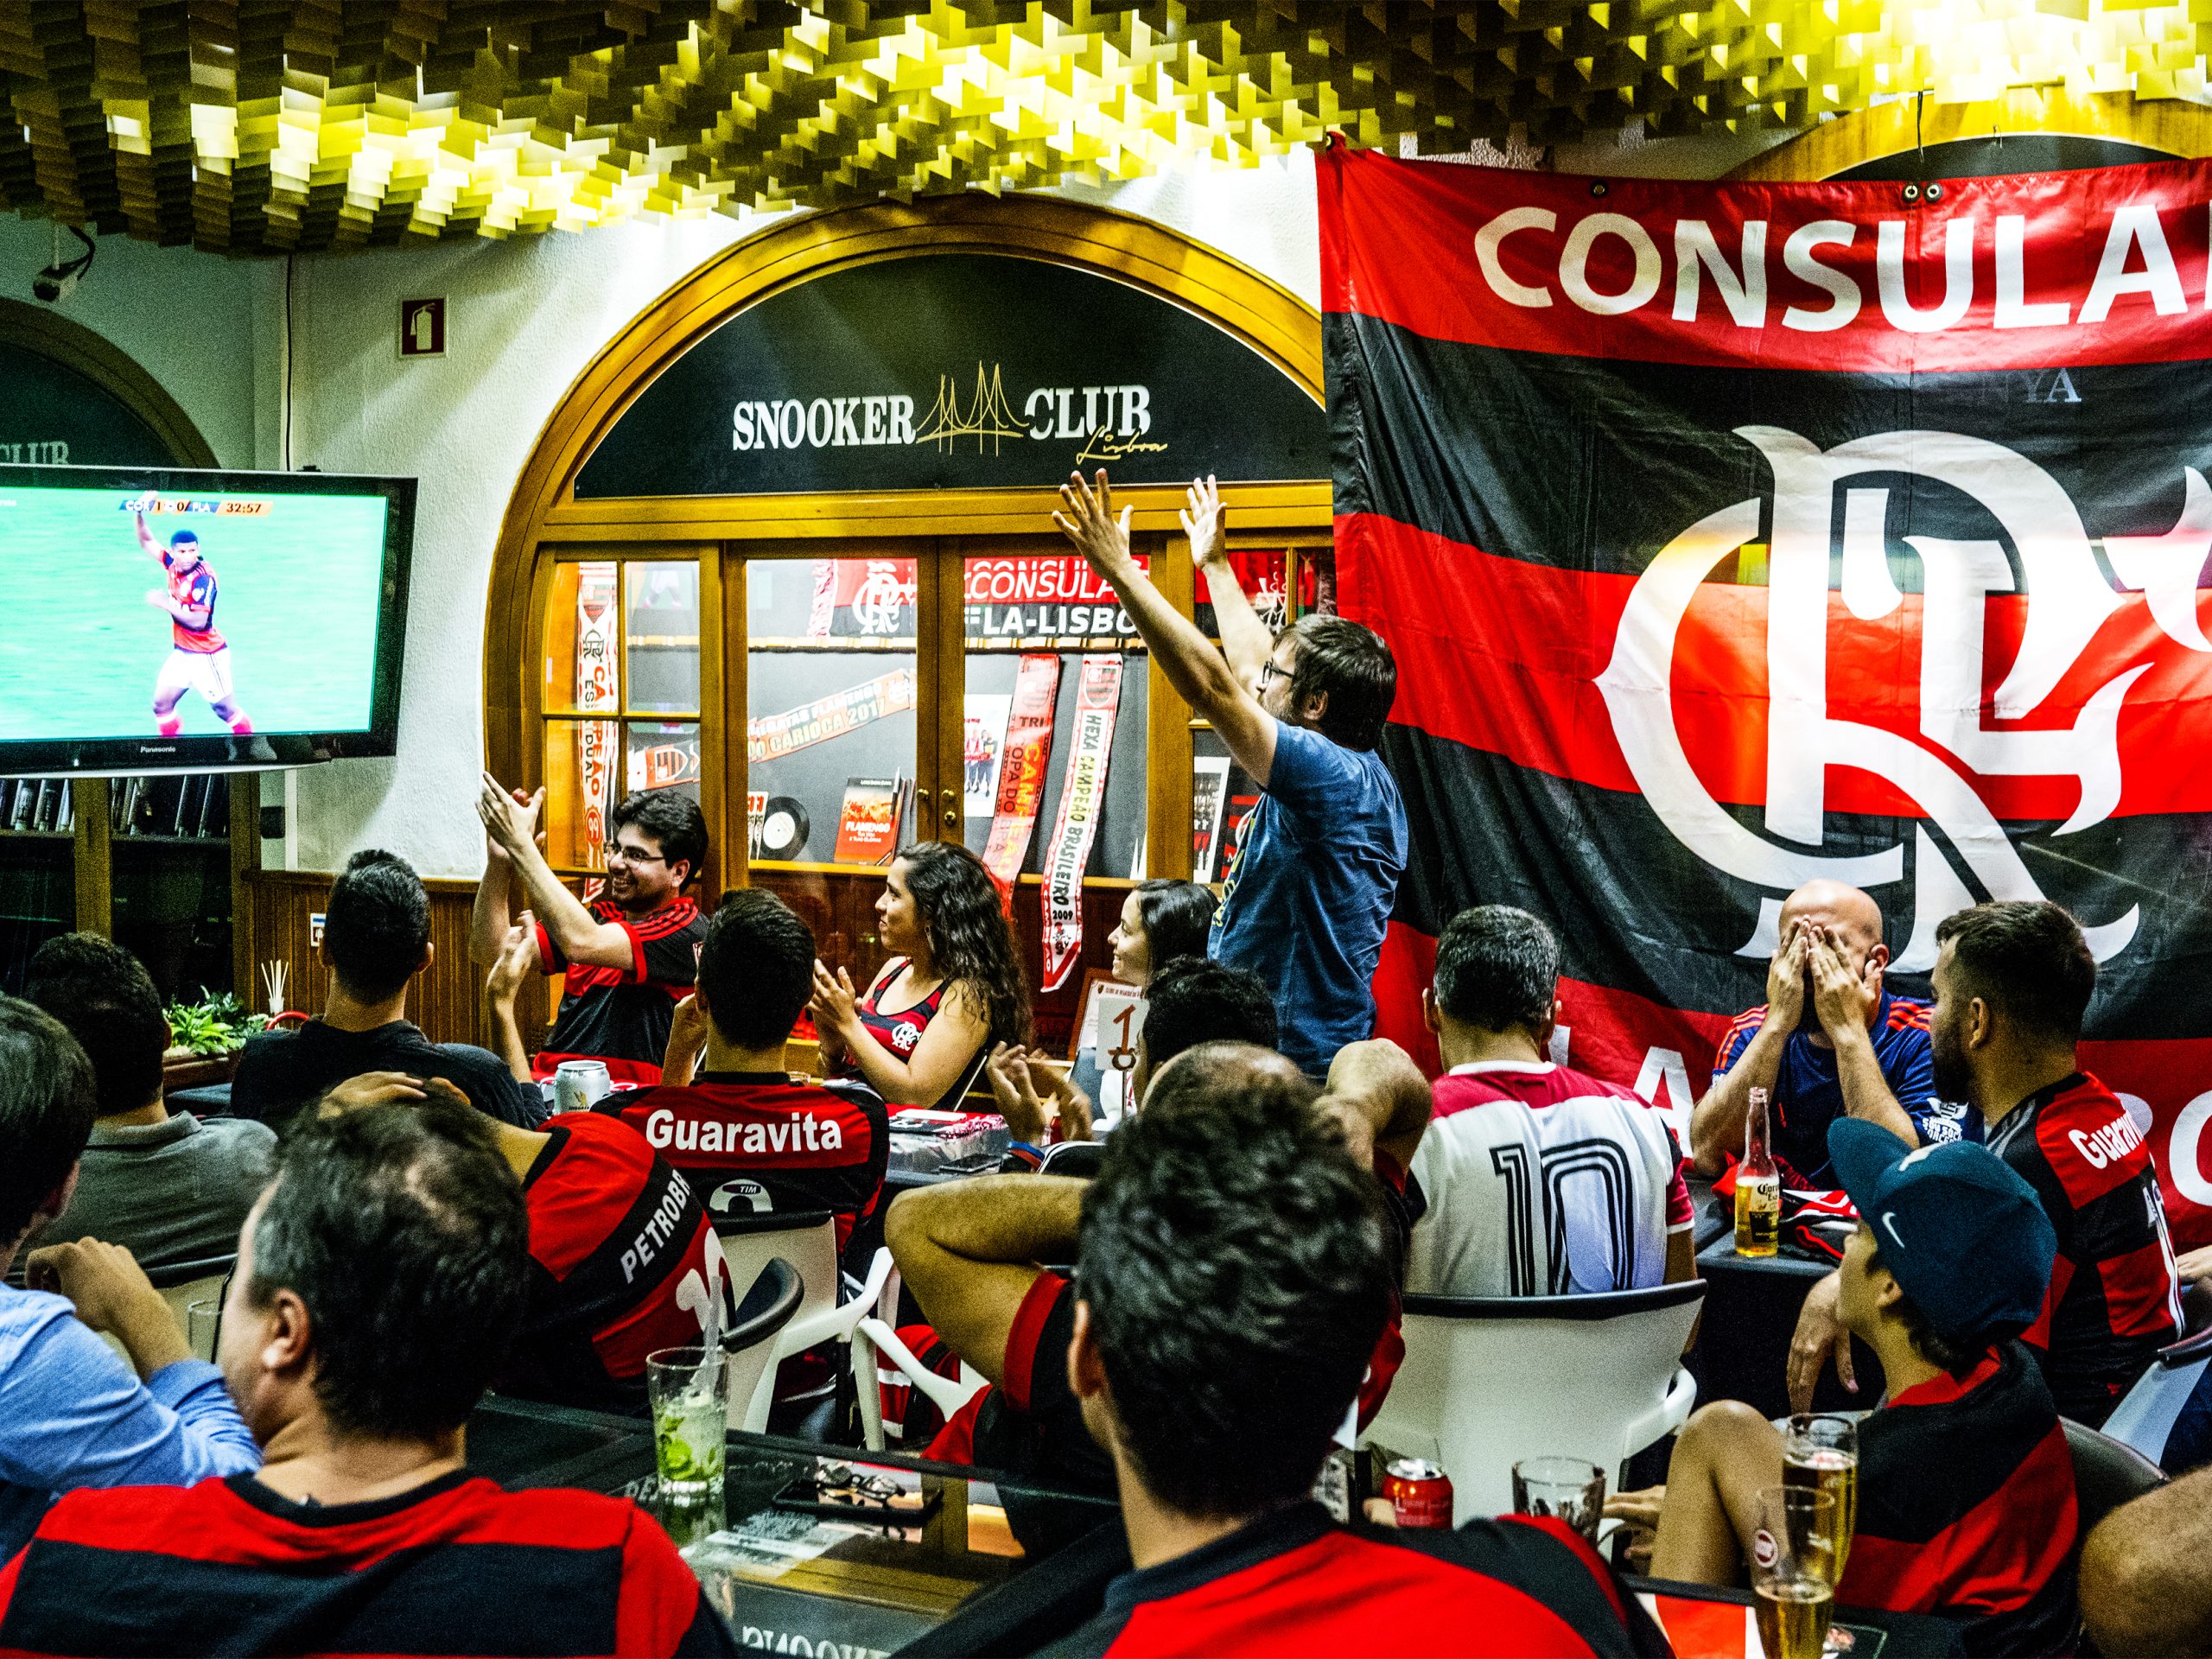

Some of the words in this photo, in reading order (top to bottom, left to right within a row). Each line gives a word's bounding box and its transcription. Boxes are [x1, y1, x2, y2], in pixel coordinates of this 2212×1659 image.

[1473, 204, 2212, 332] CONSULA
[732, 394, 916, 451] SNOOKER
[1027, 385, 1151, 440] CLUB
[1077, 424, 1168, 465] Lisboa
[226, 502, 262, 513] 32:57
[585, 679, 594, 784] ESDUAL
[591, 665, 607, 797] CAPEÃO
[770, 712, 844, 753] CARIOCA
[847, 697, 886, 726] 2017
[1083, 715, 1102, 751] HEXA
[1008, 741, 1025, 783] OPA
[846, 821, 891, 834] FLAMENGO
[1052, 826, 1084, 906] BRASILEIRO
[1052, 910, 1074, 921] 2009
[645, 1109, 842, 1153] Guaravita
[740, 1185, 757, 1194] TIM
[1489, 1137, 1635, 1297] 10
